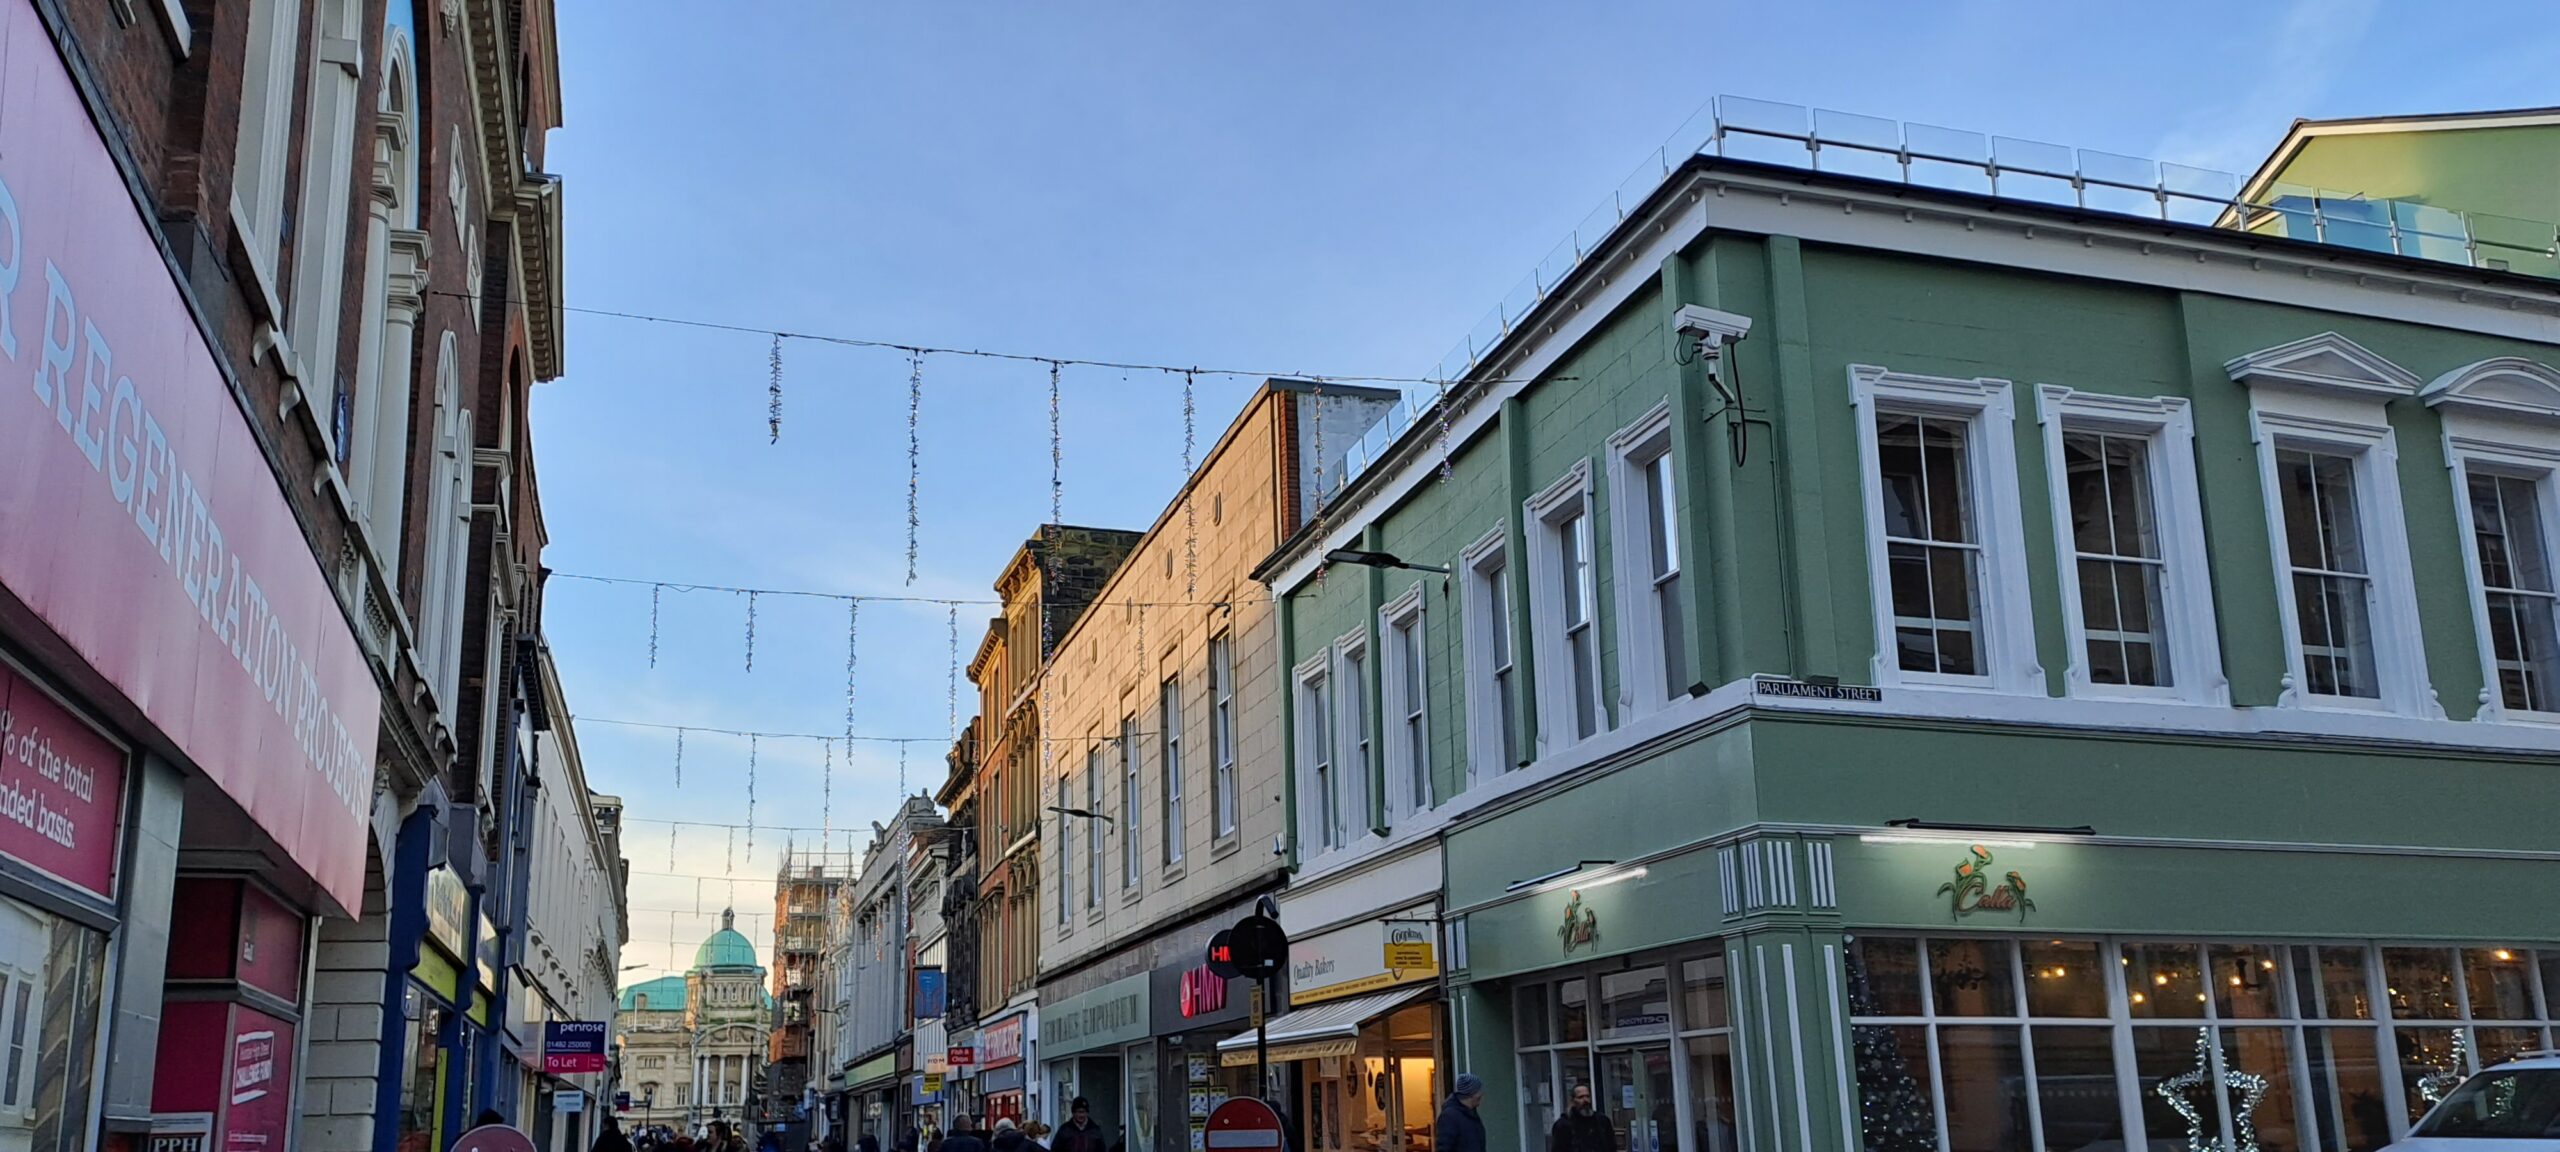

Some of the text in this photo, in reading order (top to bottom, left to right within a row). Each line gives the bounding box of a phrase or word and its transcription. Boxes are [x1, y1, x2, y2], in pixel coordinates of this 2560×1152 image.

[33, 257, 297, 725] REGENERATION
[293, 659, 369, 827] PROJECTS
[1759, 682, 1880, 700] PARLIAMENT STREET
[20, 726, 38, 767] of
[39, 737, 61, 783] the
[64, 755, 94, 803] total
[37, 793, 75, 849] basis.
[1293, 956, 1335, 986] Quality Bakers
[1192, 964, 1225, 1015] HMV
[560, 1023, 604, 1035] penrose
[546, 1056, 577, 1067] To Let
[154, 1137, 199, 1152] PPH
